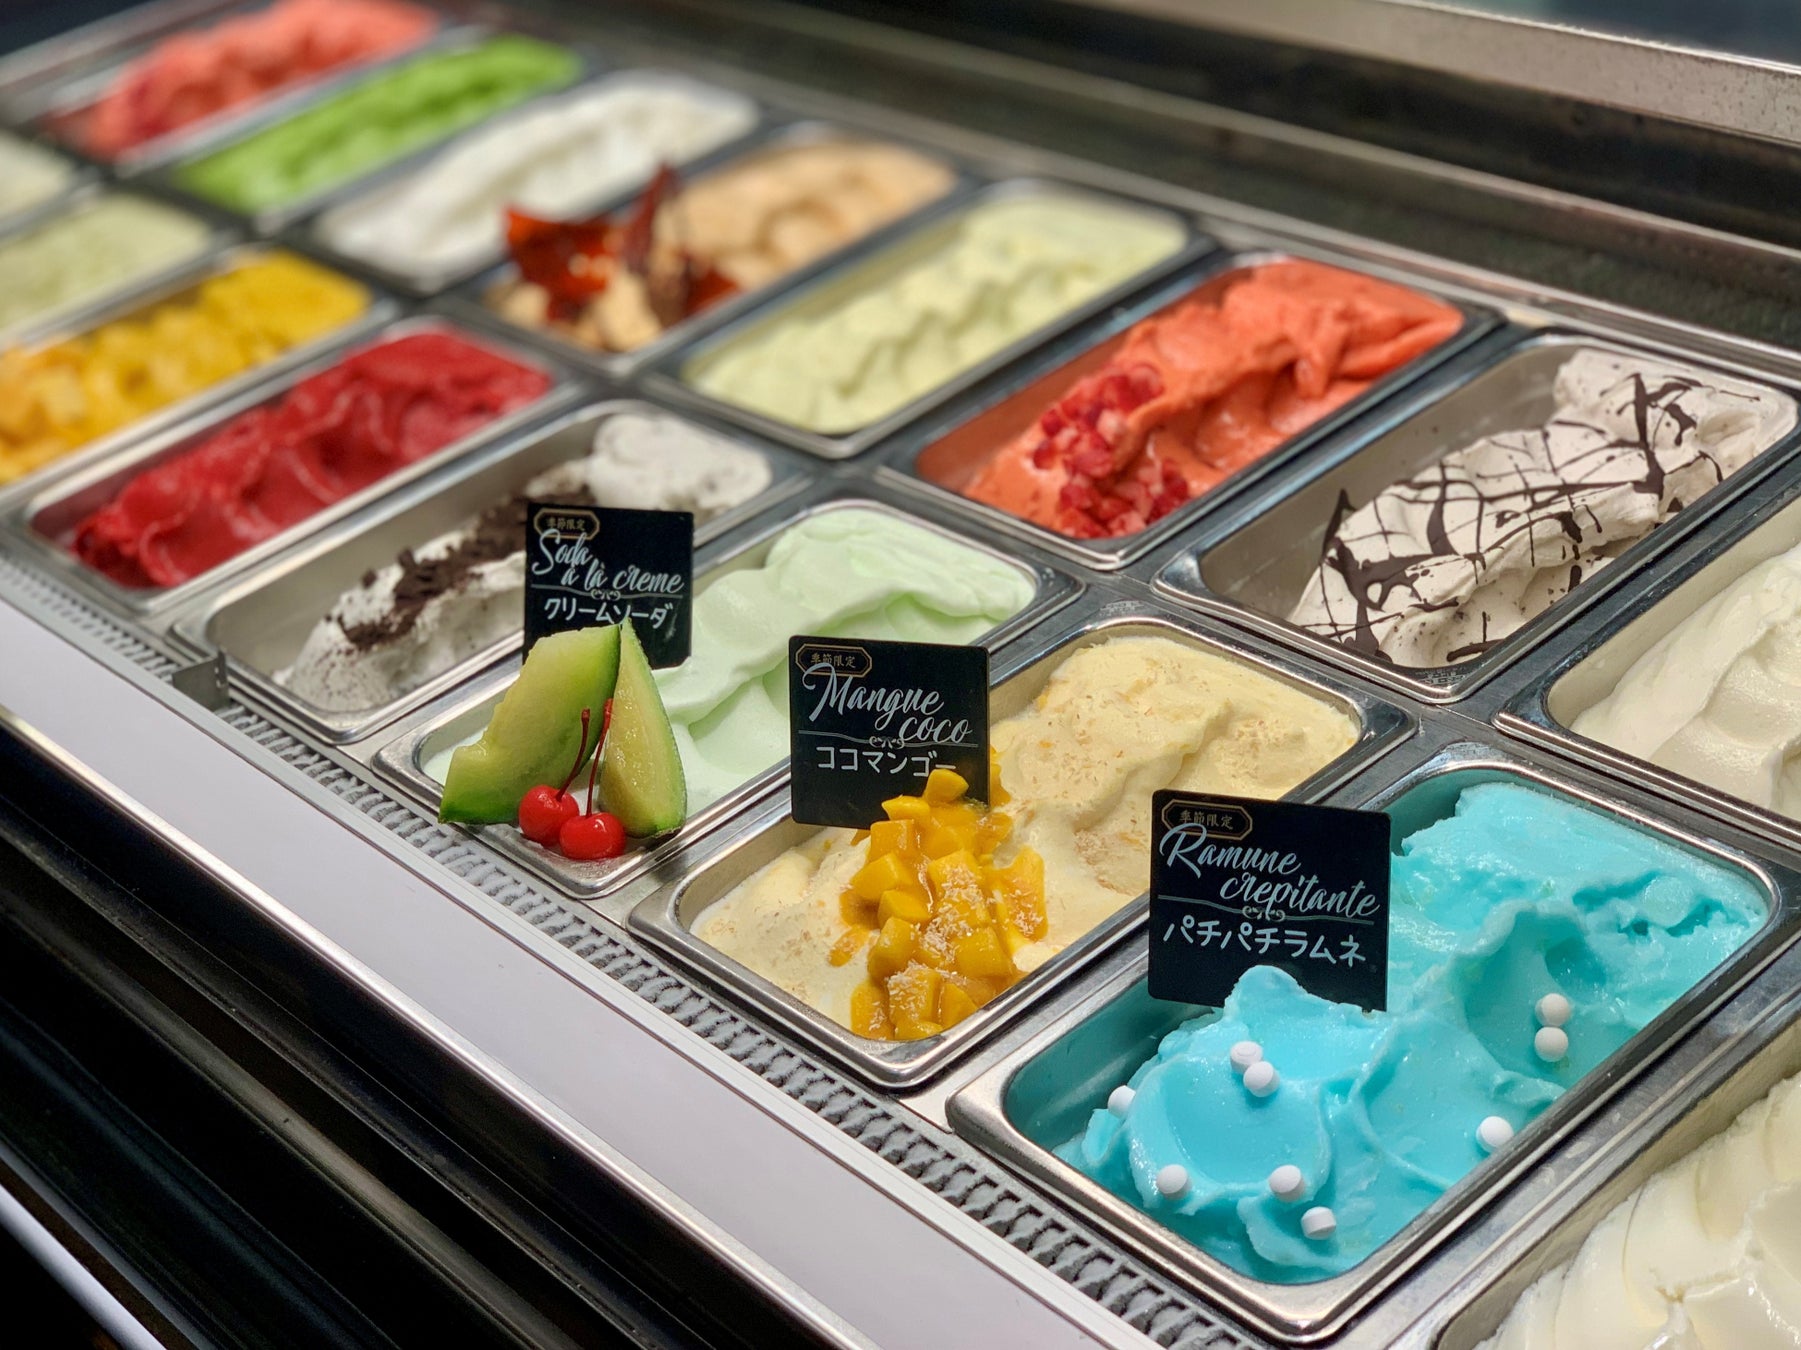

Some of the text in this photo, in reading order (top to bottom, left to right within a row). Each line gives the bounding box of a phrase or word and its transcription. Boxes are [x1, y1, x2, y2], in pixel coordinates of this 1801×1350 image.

[544, 597, 674, 629] クリームソーダ
[802, 662, 945, 731] Mangue
[898, 716, 973, 744] coco
[816, 746, 957, 777] ココマンゴー
[1159, 822, 1302, 879] Ramune
[1219, 871, 1381, 919] crepitante
[1162, 914, 1367, 967] パチパチラムネ
